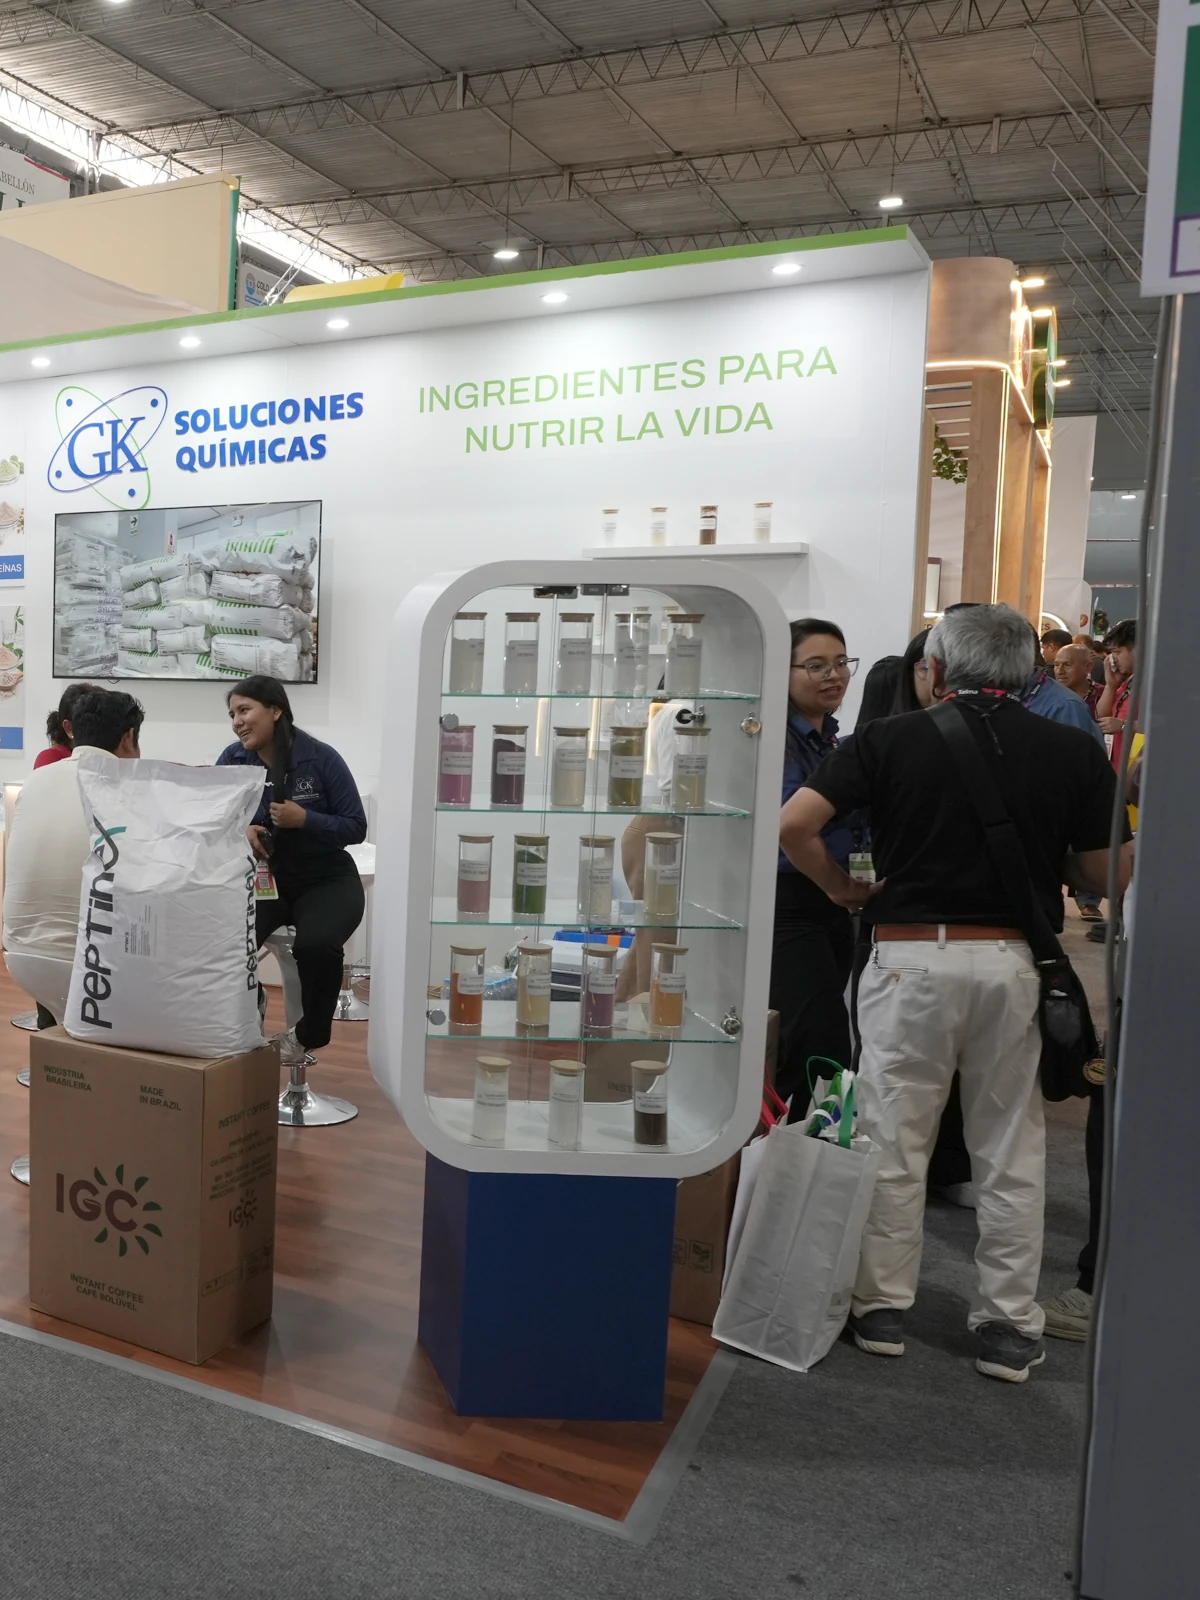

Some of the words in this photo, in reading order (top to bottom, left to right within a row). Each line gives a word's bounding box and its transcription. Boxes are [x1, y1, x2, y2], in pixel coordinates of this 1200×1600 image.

[418, 358, 706, 414] INGREDIENTES
[718, 346, 838, 385] PARA
[67, 416, 148, 480] GK
[175, 392, 364, 436] SOLUCIONES
[465, 415, 605, 454] NUTRIR
[616, 411, 665, 442] LA
[674, 401, 774, 438] VIDA
[175, 433, 327, 473] QUÍMICAS
[46, 1074, 92, 1092] BRASILEIRA
[140, 1085, 164, 1097] MADE
[607, 1081, 633, 1093] INST
[139, 1095, 148, 1104] IN
[150, 1097, 182, 1111] BRAZIL
[56, 1172, 138, 1232] IGC
[228, 1200, 255, 1228] IGC
[70, 1273, 105, 1291] INSTANT
[108, 1286, 144, 1304] COFFEE
